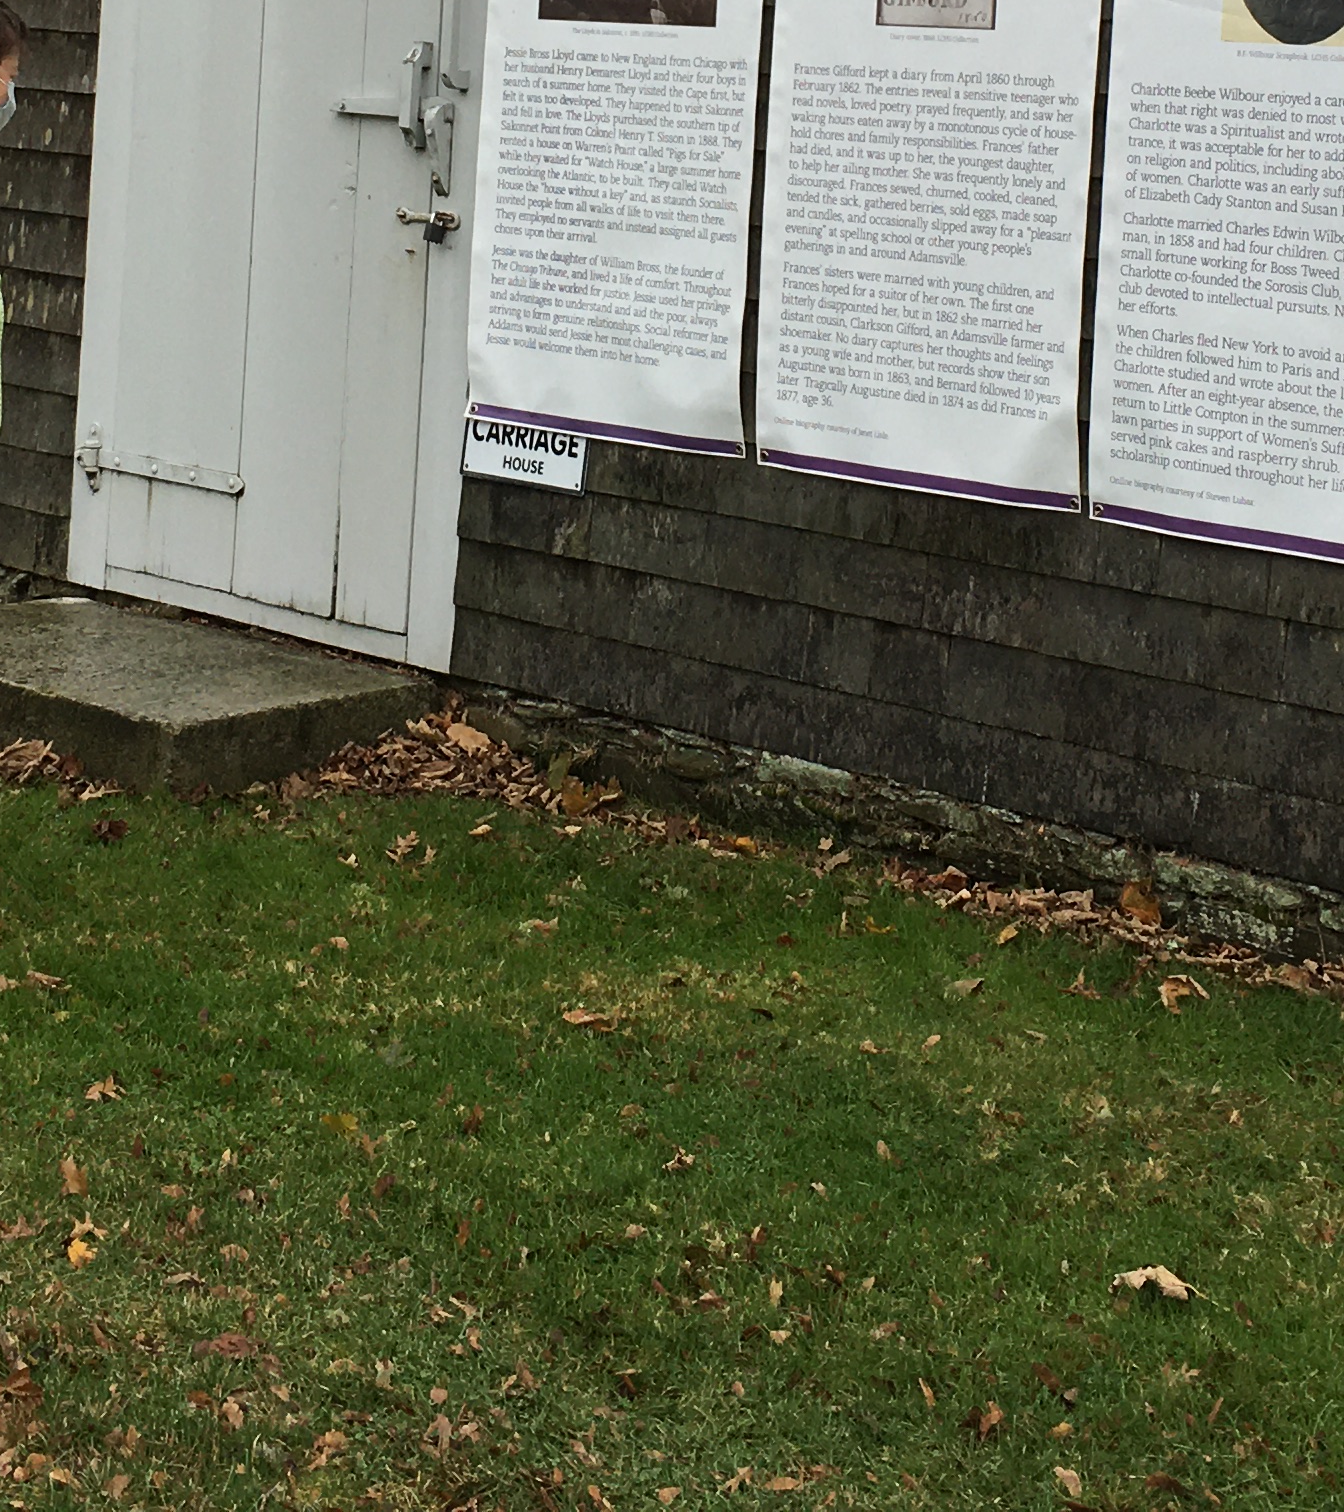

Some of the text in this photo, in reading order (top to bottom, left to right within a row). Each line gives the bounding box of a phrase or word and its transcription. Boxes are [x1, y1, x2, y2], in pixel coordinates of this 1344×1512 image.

[793, 62, 1054, 90] Frances Gifford kept a diary from April 1860 through
[1130, 82, 1181, 97] Charlotte
[1183, 85, 1216, 99] Beebe
[1218, 87, 1265, 102] Wilbour
[1267, 91, 1311, 108] enjoyed
[1314, 95, 1321, 106] a
[1123, 211, 1174, 228] Charlotte
[1176, 219, 1222, 232] married
[1225, 220, 1269, 237] Charles
[1272, 224, 1309, 241] Edwin
[824, 267, 854, 279] sisters
[856, 270, 881, 282] were
[883, 273, 924, 286] married
[926, 276, 949, 289] with
[952, 280, 984, 296] young
[1034, 287, 1054, 300] and
[472, 420, 579, 458] CARRIAGE
[502, 455, 545, 475] HOUSE
[1109, 448, 1170, 470] scholarship
[1172, 458, 1231, 476] continued
[1234, 463, 1304, 486] throughout
[1307, 473, 1328, 490] her
